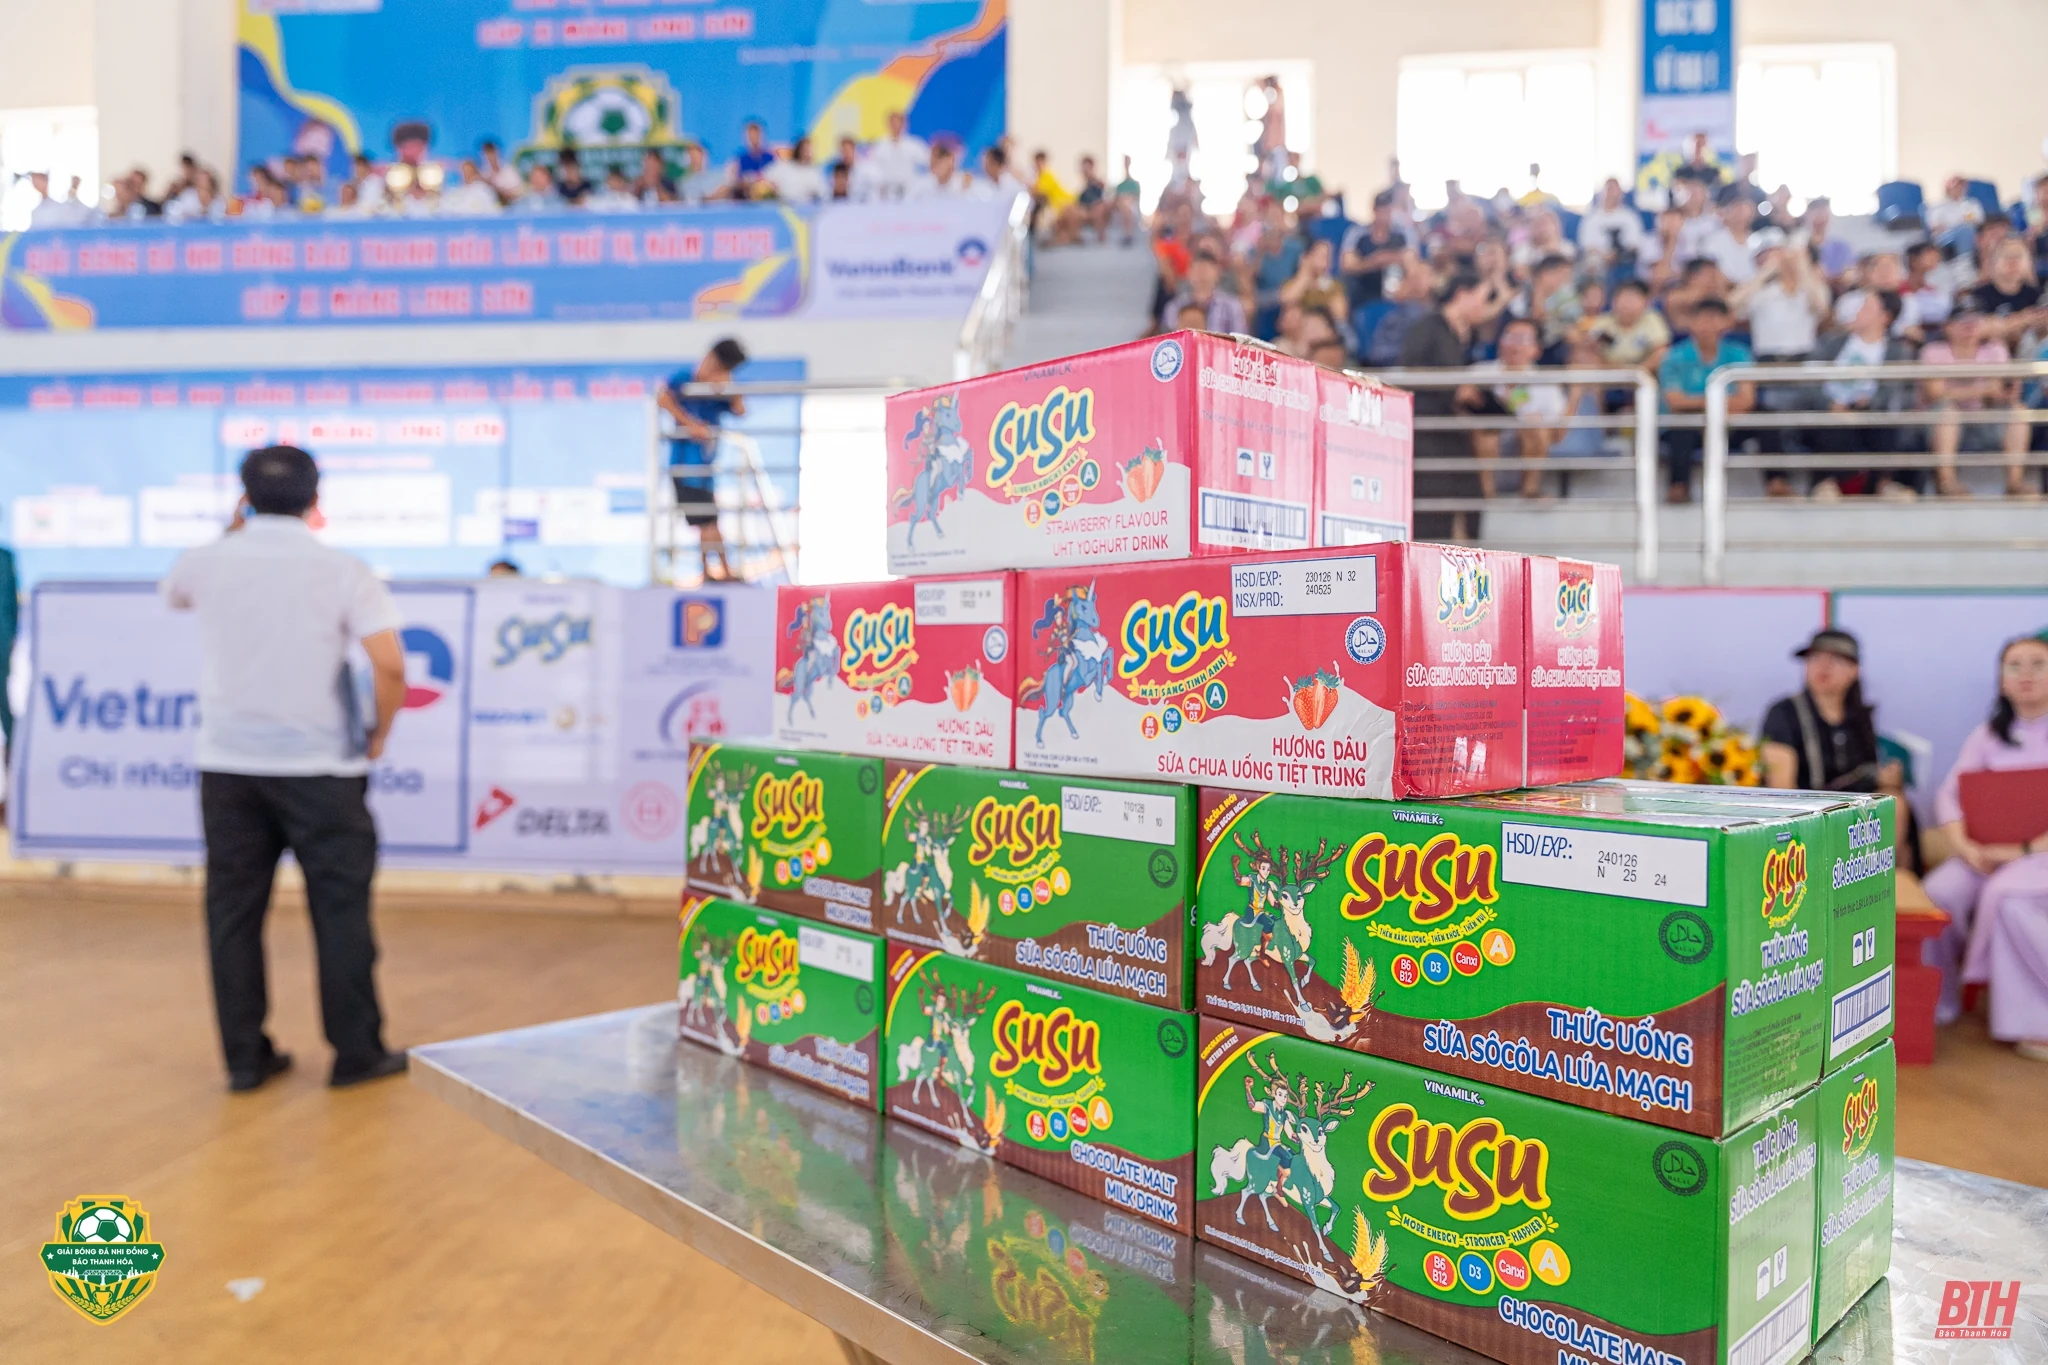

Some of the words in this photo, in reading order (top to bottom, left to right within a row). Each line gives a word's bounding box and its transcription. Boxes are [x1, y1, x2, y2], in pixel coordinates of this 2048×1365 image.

[989, 387, 1093, 485] SuSu
[1083, 463, 1097, 485] A
[1046, 515, 1113, 535] STRAWBERRY
[1115, 509, 1169, 530] FLAVOUR
[1053, 541, 1075, 557] UHT
[1076, 537, 1129, 556] YOGHURT
[1132, 534, 1169, 552] DRINK
[1235, 571, 1283, 588] HSD/EXP:
[1305, 570, 1332, 583] 230126
[1336, 570, 1344, 582] N
[1347, 569, 1357, 582] 32
[1235, 591, 1284, 608] NSX/PRD:
[1305, 583, 1332, 596] 240525
[843, 605, 913, 670] SuSu
[1121, 594, 1227, 677] SuSu
[1186, 673, 1208, 690] TINH
[1207, 657, 1227, 678] ANH
[1210, 684, 1223, 705] A
[1272, 734, 1326, 760] HƯƠNG
[1333, 734, 1368, 763] DÂU
[1157, 750, 1185, 774] SỮA
[1188, 755, 1228, 778] CHUA
[1231, 753, 1273, 778] UỐNG
[1277, 758, 1309, 788] TIỆT
[1311, 762, 1367, 788] TRÙNG
[754, 773, 823, 836] SuSu
[1123, 812, 1129, 822] N
[1138, 814, 1145, 825] 11
[1156, 817, 1162, 827] 10
[1392, 809, 1439, 825] VINAMILK
[969, 799, 1061, 865] SuSu
[1598, 850, 1638, 868] 240126
[1344, 836, 1496, 922] SuSu
[1597, 865, 1606, 878] N
[1623, 868, 1638, 883] 25
[1654, 873, 1667, 887] 24
[1762, 841, 1807, 917] SuSu
[738, 930, 798, 985] SuSu
[1087, 921, 1125, 955] THỨC
[1125, 926, 1168, 963] UỐNG
[1489, 934, 1509, 959] A
[1761, 930, 1785, 970] THỨC
[1785, 922, 1808, 963] UỐNG
[1016, 937, 1044, 967] SỮA
[1045, 943, 1099, 977] SÔCÔLA
[1099, 956, 1124, 986] LÚA
[1125, 965, 1167, 997] MẠCH
[1400, 959, 1412, 972] B6
[1430, 960, 1442, 974] D3
[1456, 950, 1479, 967] Canxi
[1399, 970, 1413, 984] B12
[1731, 978, 1754, 1018] SỮA
[1754, 968, 1789, 1009] SÔCÔLA
[1788, 961, 1805, 997] LÚA
[1804, 957, 1824, 996] MẠCH
[992, 1003, 1100, 1085] SuSu
[1546, 1005, 1613, 1049] THỨC
[1616, 1015, 1693, 1067] UỐNG
[1423, 1019, 1469, 1060] SỮA
[1470, 1027, 1561, 1082] SÔCÔLA
[1563, 1050, 1614, 1094] LÚA
[1615, 1066, 1692, 1113] MẠCH
[1423, 1079, 1480, 1105] VINAMILK
[1094, 1101, 1109, 1124] A
[1843, 1080, 1878, 1154] SuSu
[1752, 1127, 1776, 1170] THỨC
[1775, 1114, 1798, 1157] UỐNG
[1070, 1139, 1142, 1184] CHOCOLATE
[1142, 1166, 1178, 1197] MALT
[1366, 1104, 1547, 1218] SuSu
[1105, 1177, 1136, 1209] MILK
[1137, 1190, 1179, 1226] DRINK
[1730, 1184, 1749, 1226] SỮA
[1748, 1166, 1780, 1213] SÔCÔLA
[1402, 1215, 1426, 1236] MORE
[1426, 1225, 1458, 1246] ENERGY
[1464, 1232, 1507, 1248] STRONGER
[1511, 1218, 1544, 1244] HAPPIER
[1431, 1268, 1448, 1287] B12
[1432, 1255, 1447, 1271] B6
[1468, 1264, 1482, 1281] D3
[1498, 1258, 1526, 1281] Canxi
[1538, 1247, 1561, 1279] A
[1498, 1295, 1620, 1363] CHOCOLATE
